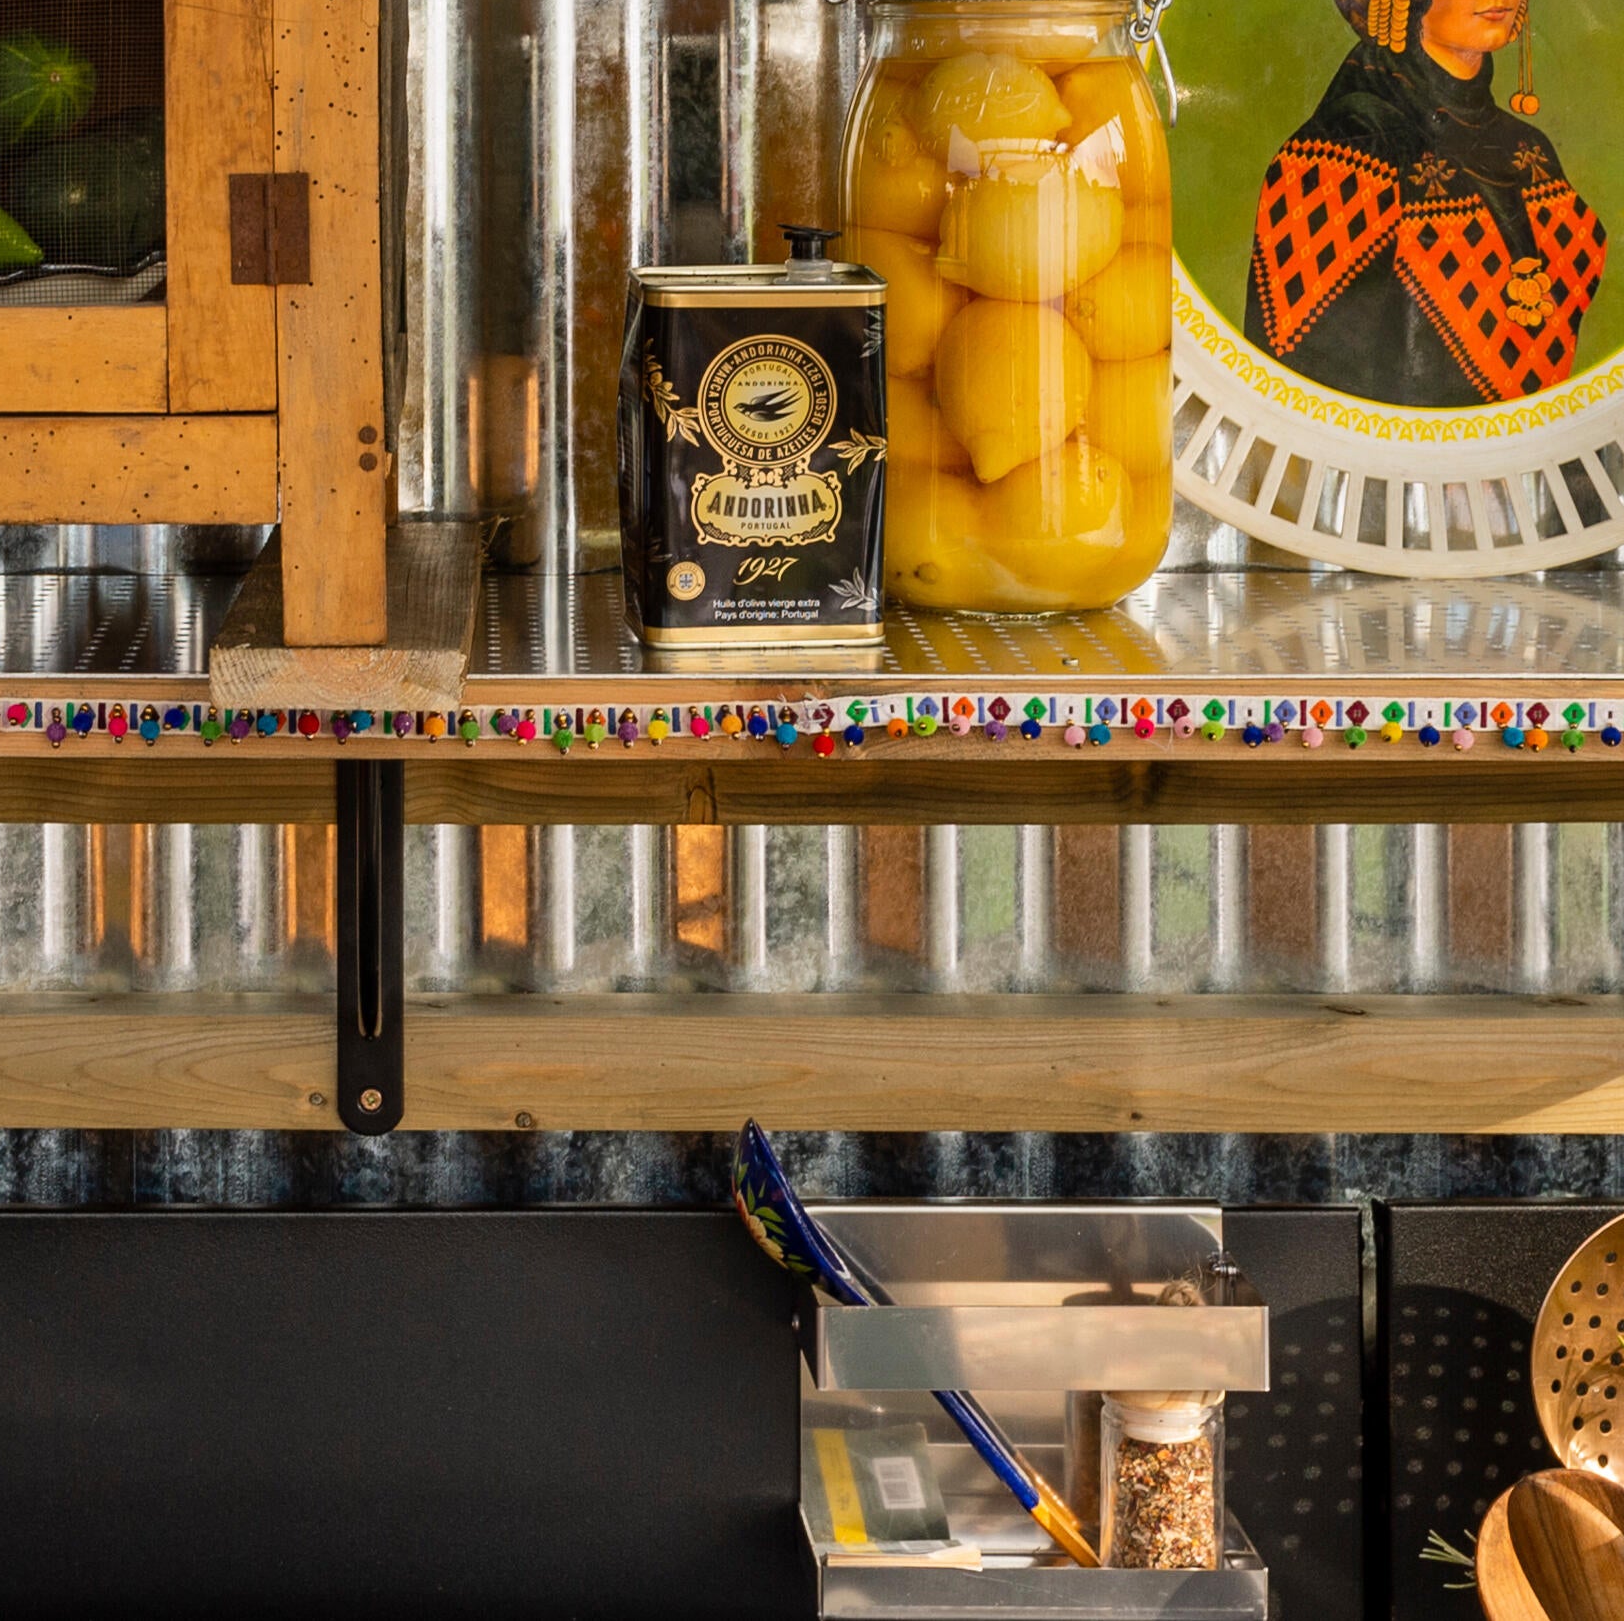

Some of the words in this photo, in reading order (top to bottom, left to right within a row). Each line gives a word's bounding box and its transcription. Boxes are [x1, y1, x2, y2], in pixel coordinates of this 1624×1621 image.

[733, 344, 804, 365] ANDORINHA
[708, 360, 734, 398] MARCA
[744, 363, 793, 378] PORTUGAL
[802, 362, 825, 388] 1927
[812, 390, 828, 426] DESDE
[708, 401, 755, 459] PORTUGUESA
[739, 423, 769, 439] DESDE
[758, 447, 773, 460] DE
[776, 425, 817, 459] AZEITES
[707, 489, 827, 519] ANDORINHA
[740, 521, 792, 530] PORTUGAL
[733, 556, 800, 586] 1927
[712, 599, 736, 609] Huile
[738, 598, 767, 608] d'olive
[768, 598, 796, 610] vierge
[797, 599, 821, 608] extra
[714, 610, 738, 622] Pays
[739, 609, 780, 621] d'origine:
[781, 609, 819, 621] Portugal
